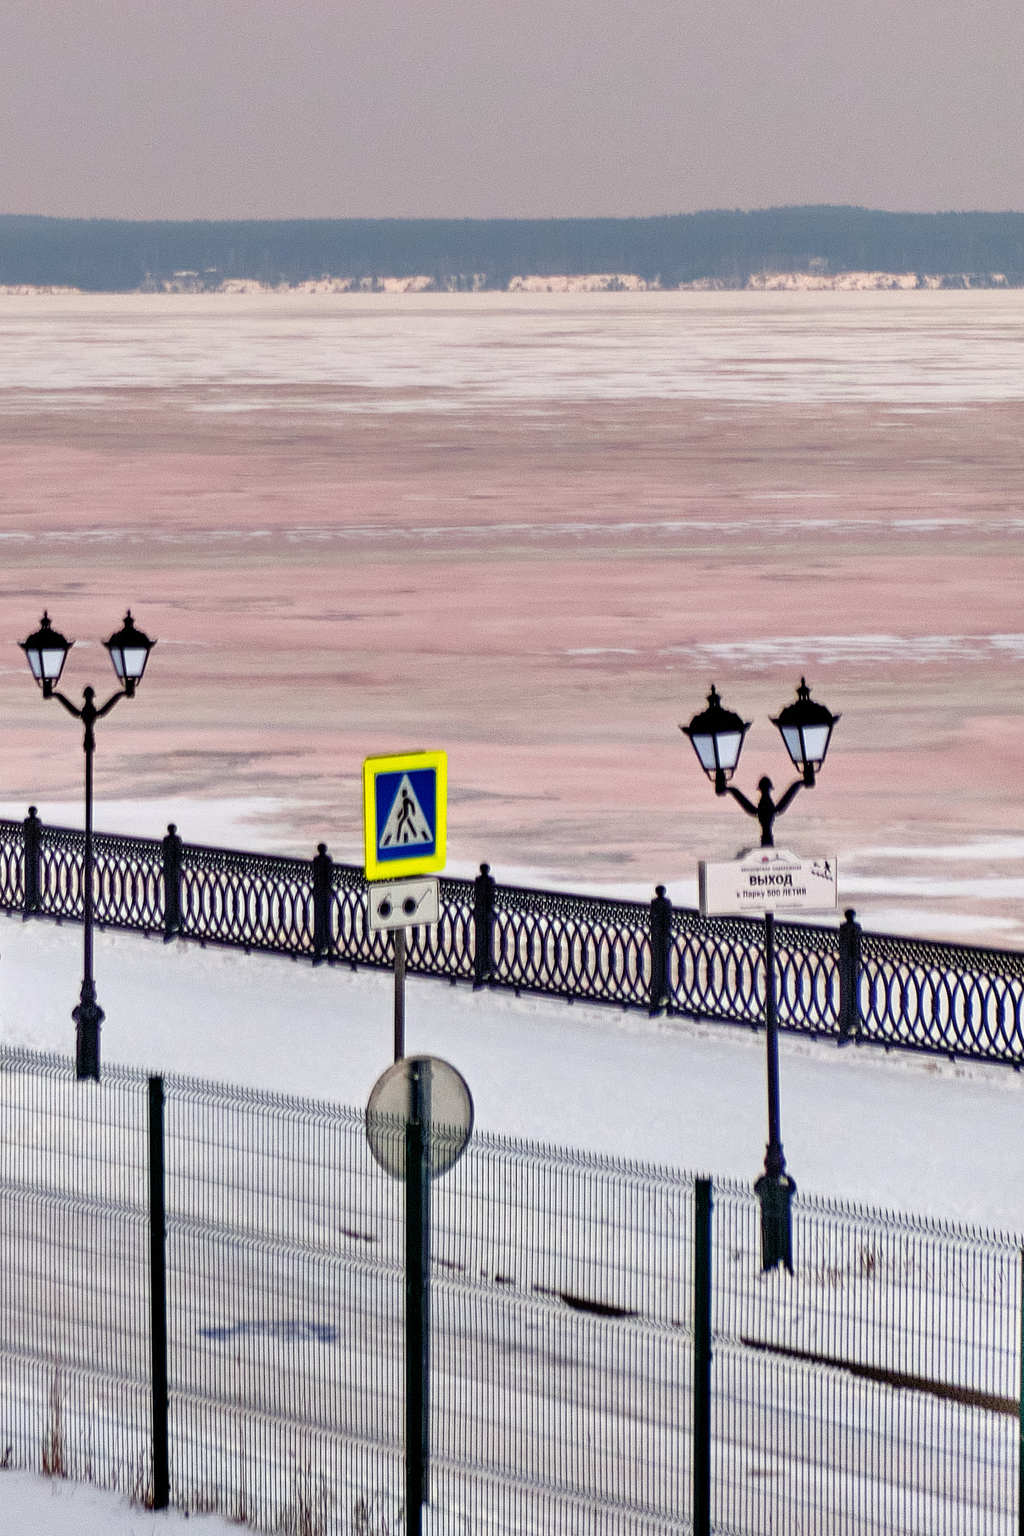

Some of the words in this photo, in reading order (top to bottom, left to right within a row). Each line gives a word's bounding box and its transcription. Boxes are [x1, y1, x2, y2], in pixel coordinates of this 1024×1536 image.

[749, 874, 793, 886] ВЫХОД
[743, 889, 765, 899] Парку
[767, 888, 781, 897] 500
